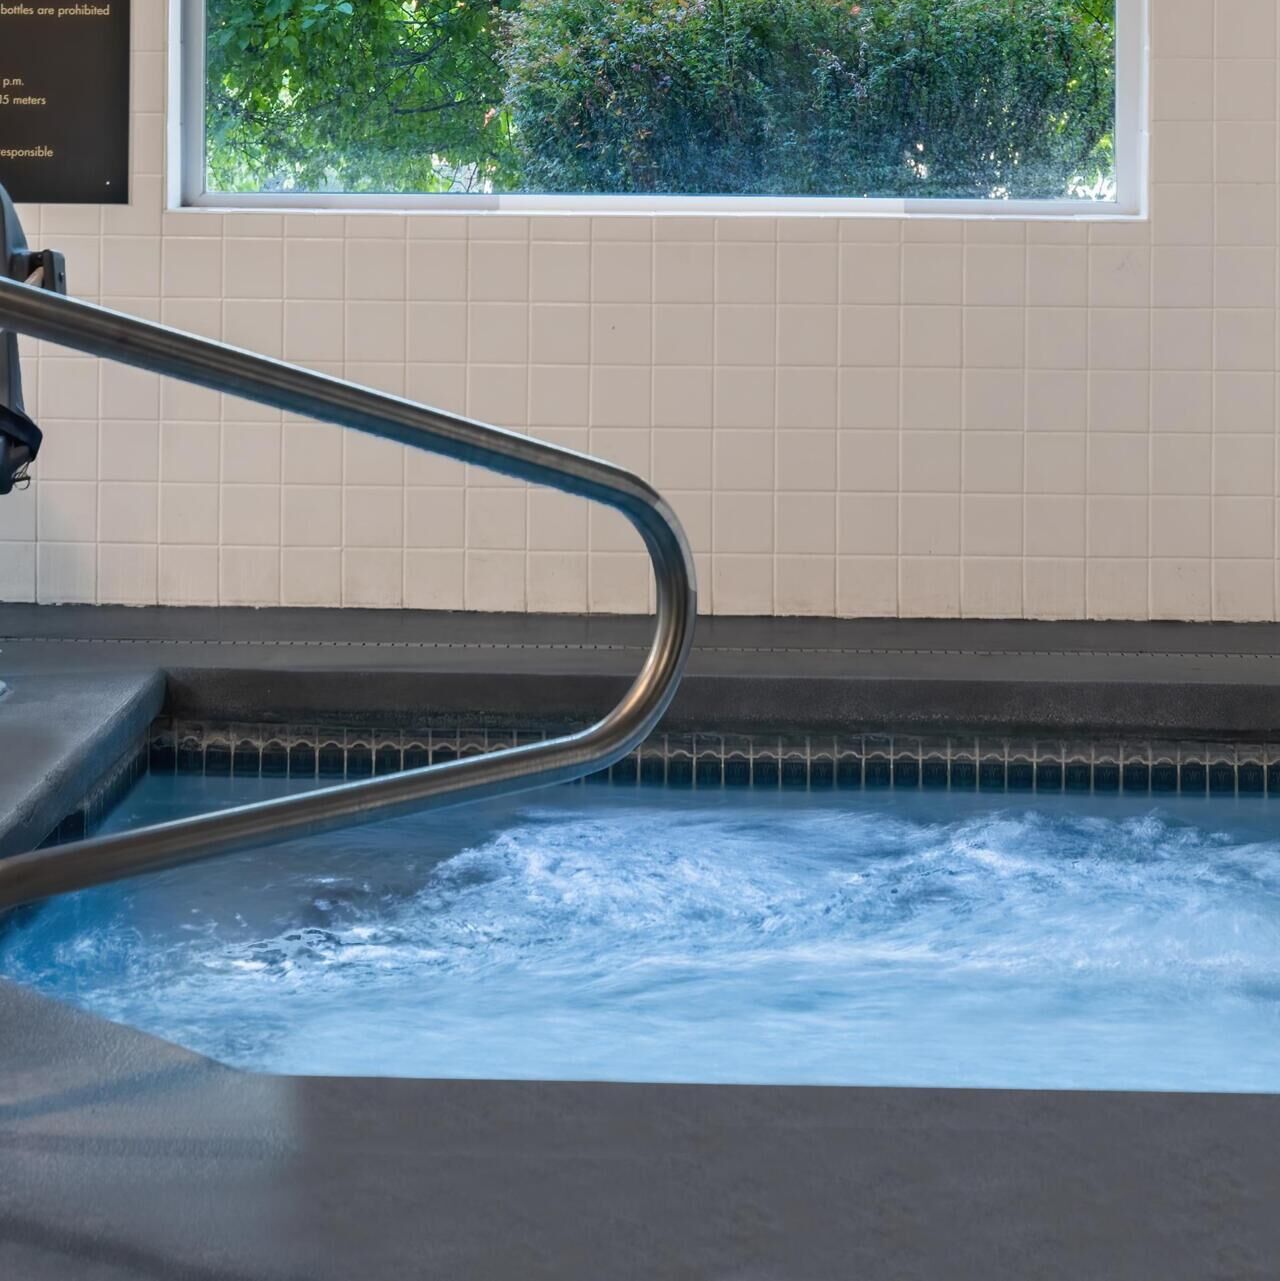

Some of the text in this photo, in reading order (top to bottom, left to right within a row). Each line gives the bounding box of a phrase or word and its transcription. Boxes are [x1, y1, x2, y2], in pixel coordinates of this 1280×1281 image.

[0, 4, 34, 14] bottles
[58, 4, 110, 18] prohibited
[2, 79, 24, 88] p.m.
[12, 96, 46, 104] meters
